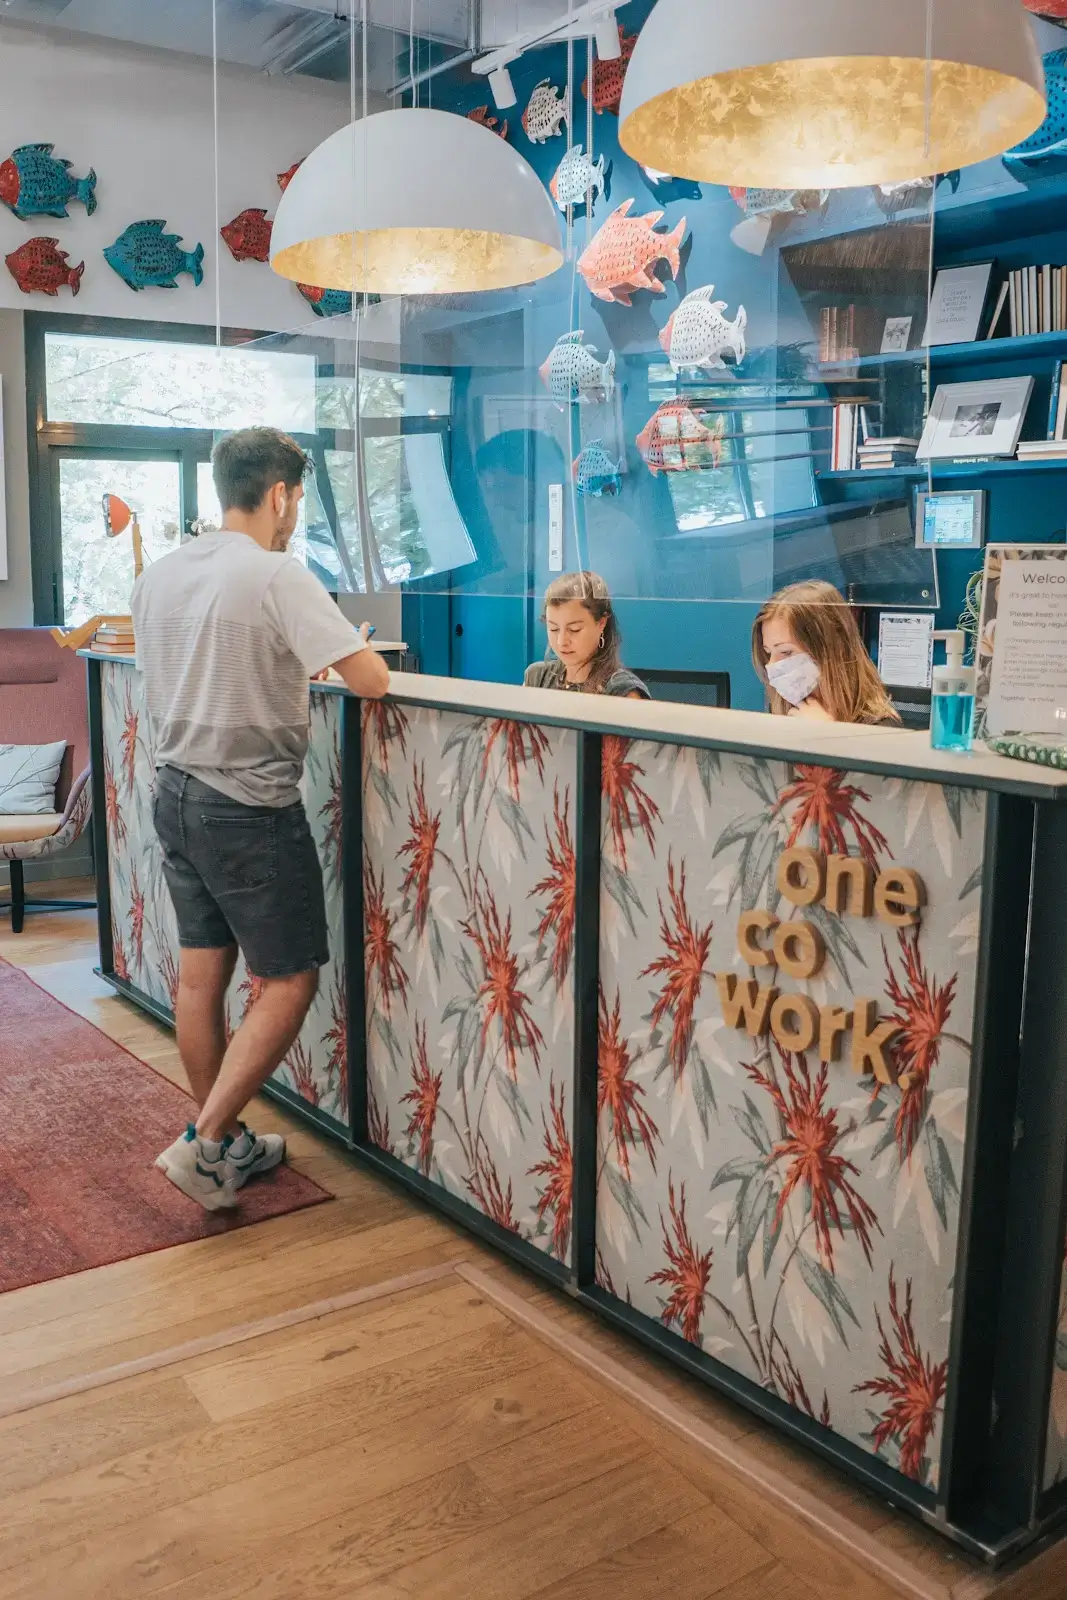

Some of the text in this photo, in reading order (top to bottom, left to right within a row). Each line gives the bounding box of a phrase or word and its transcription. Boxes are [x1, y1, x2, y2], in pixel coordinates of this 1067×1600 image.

[1022, 573, 1067, 584] Welco
[1012, 619, 1047, 629] following
[1035, 611, 1054, 619] keep
[777, 846, 927, 927] one
[736, 910, 825, 979] co
[715, 971, 911, 1091] work.
